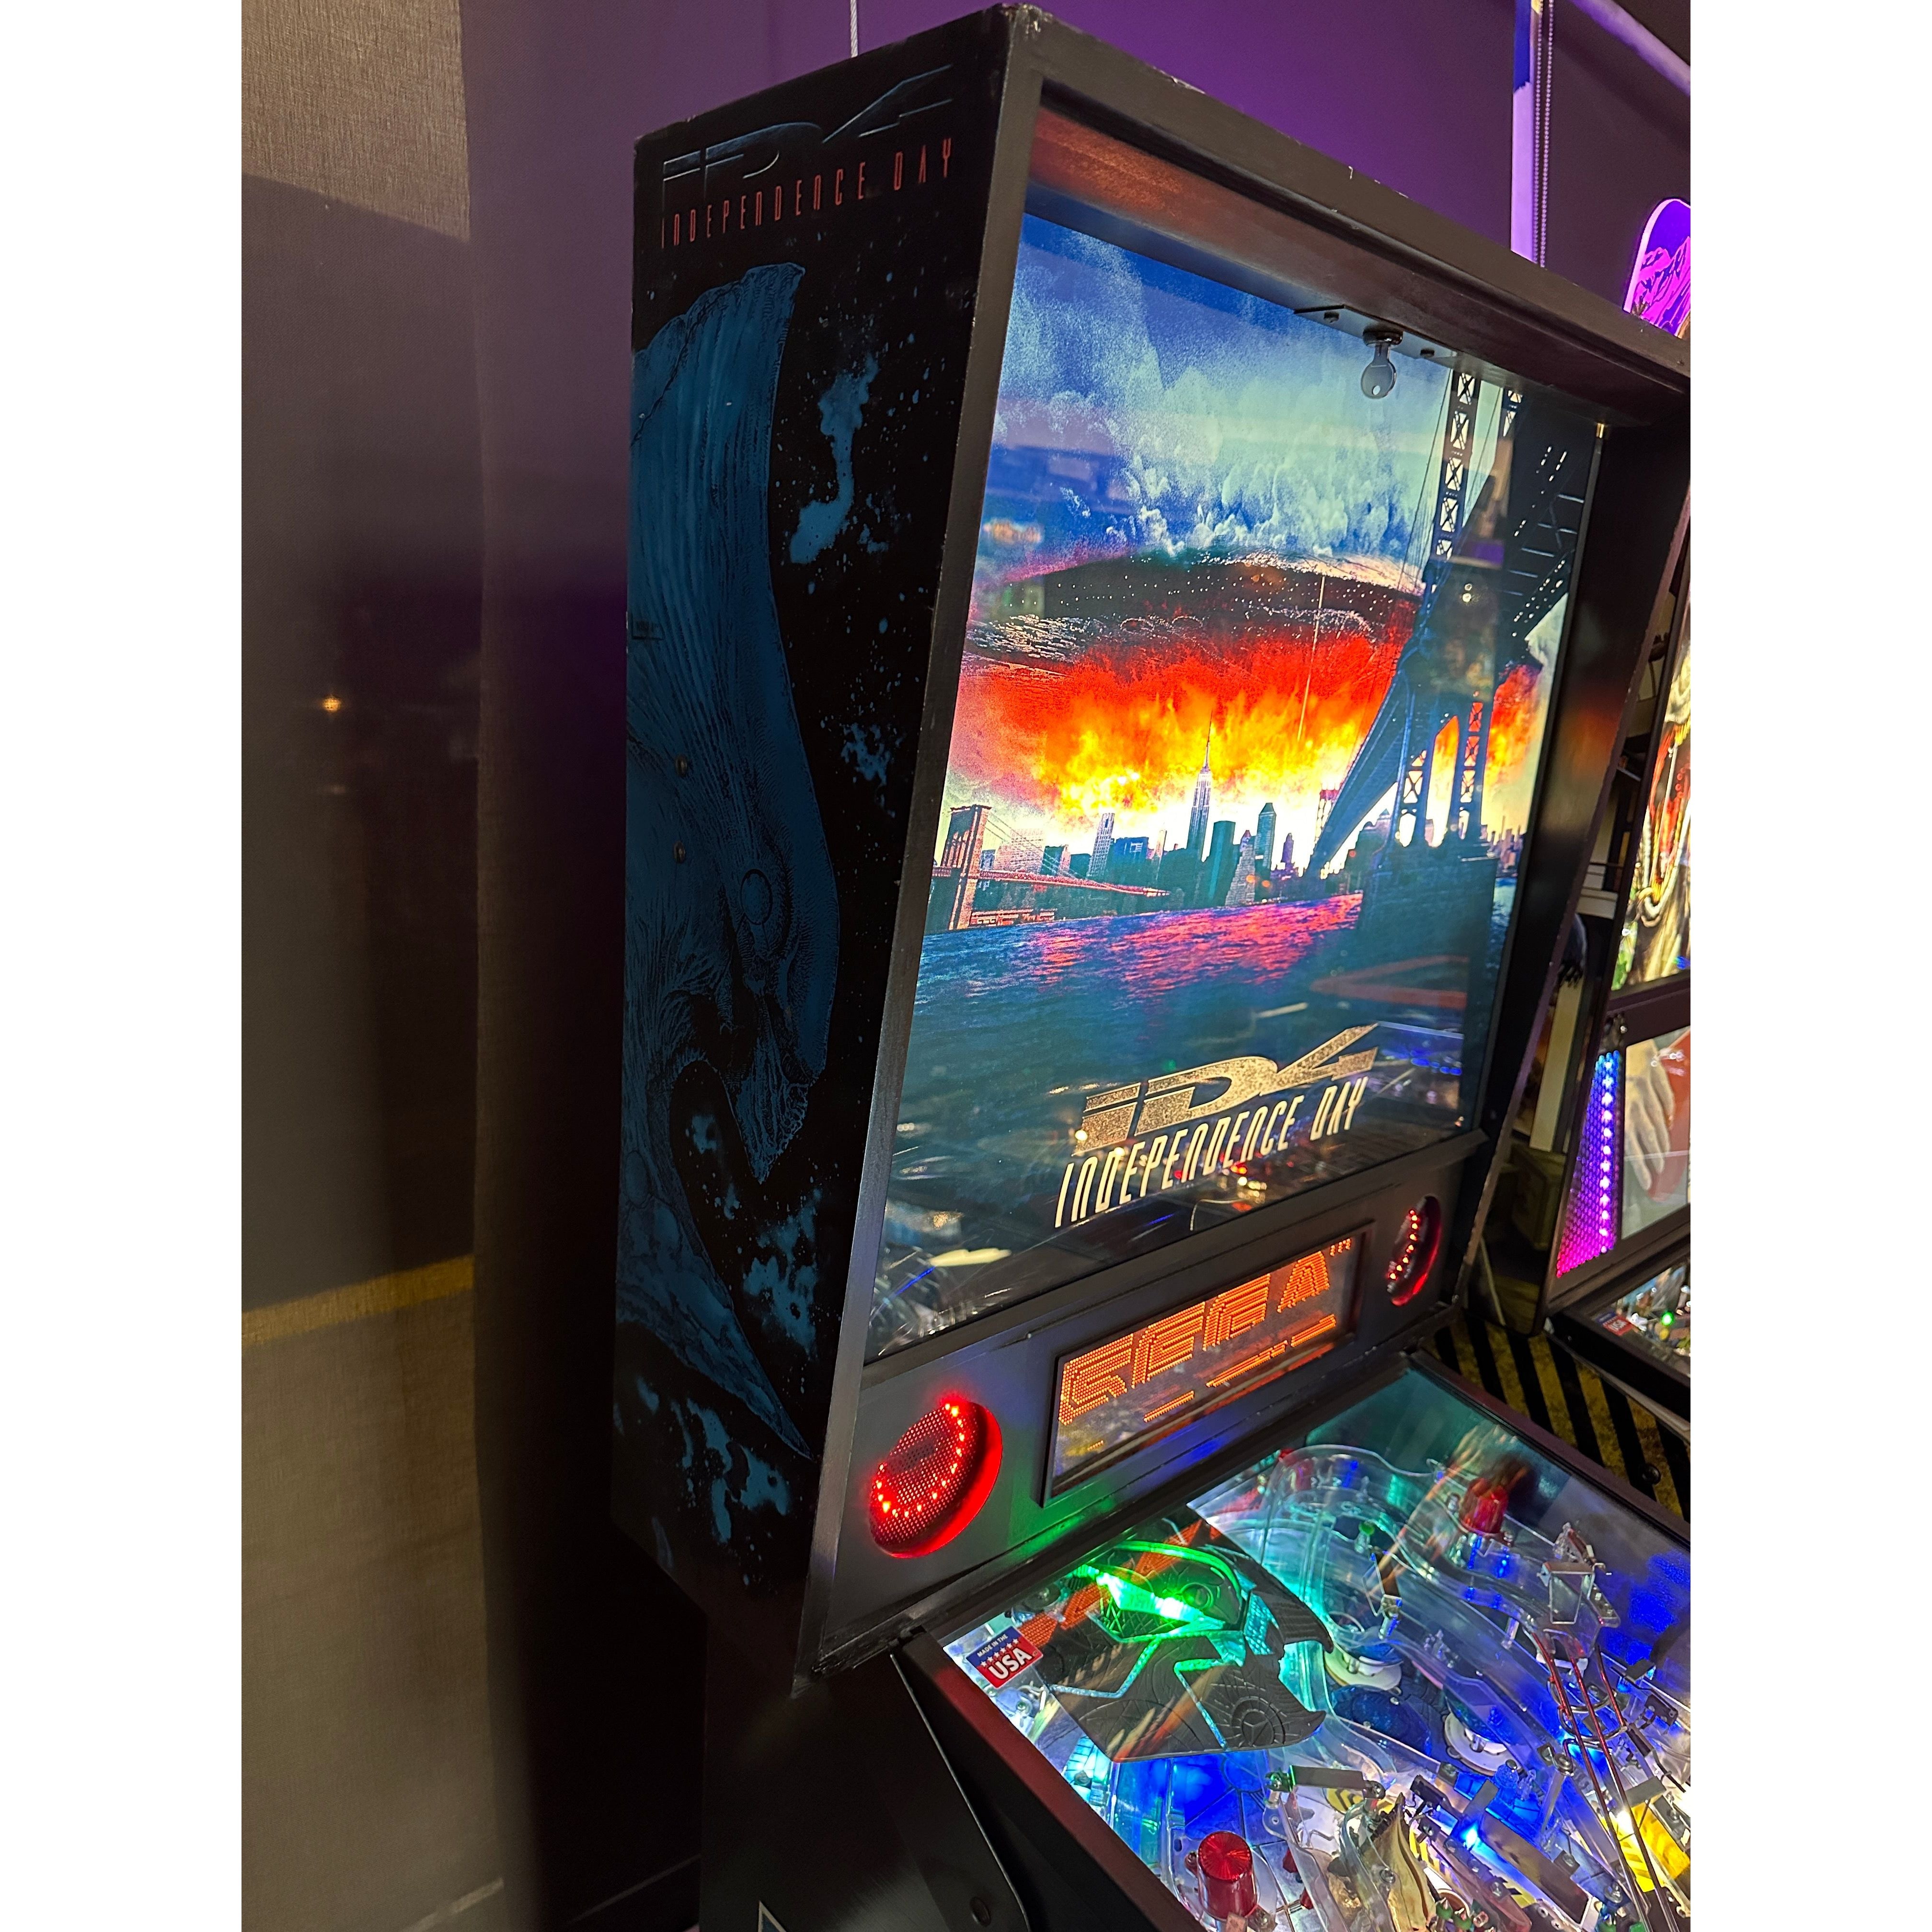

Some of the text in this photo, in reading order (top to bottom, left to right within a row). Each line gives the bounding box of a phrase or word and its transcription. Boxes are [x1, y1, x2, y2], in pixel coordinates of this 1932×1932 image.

[661, 138, 952, 249] INDEPENDENCE DAY
[1055, 1076, 1369, 1228] INDEPENDENCE DAY
[977, 1644, 993, 1657] MADE
[997, 1633, 1009, 1643] THE
[988, 1647, 1033, 1679] USA
